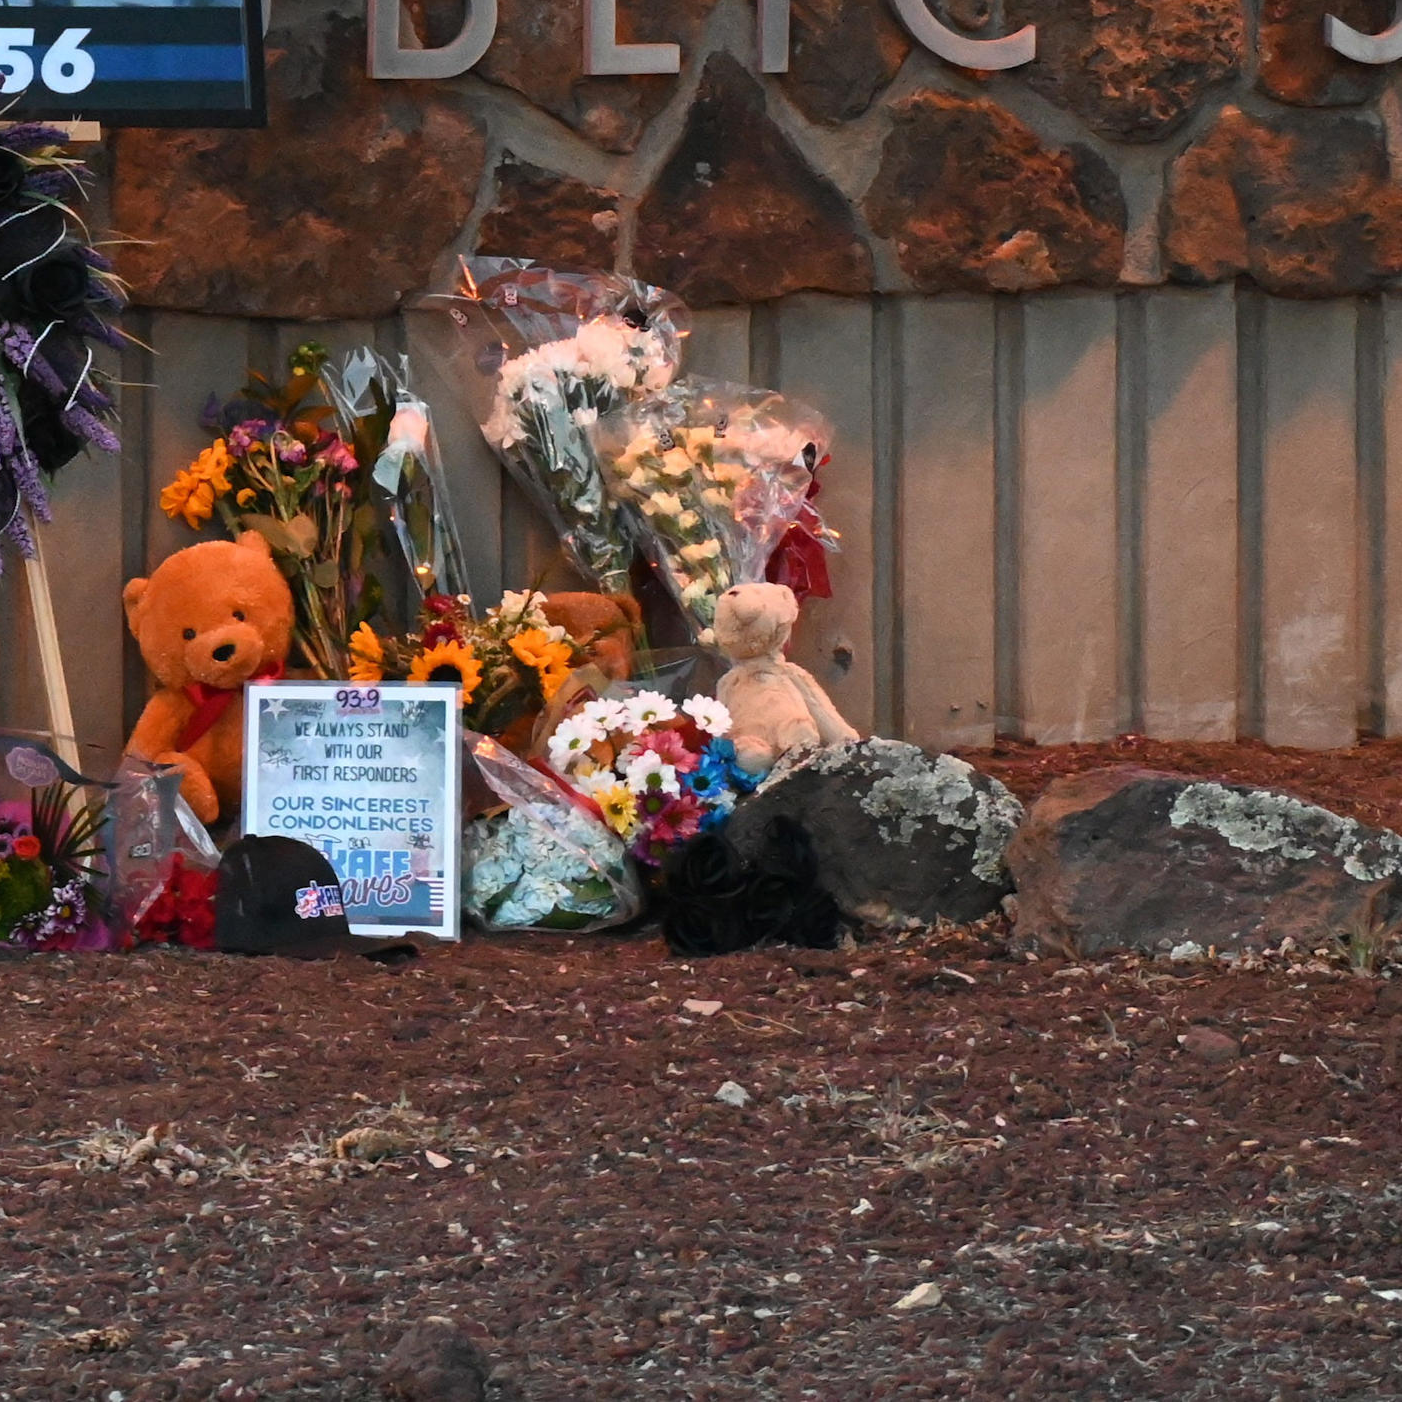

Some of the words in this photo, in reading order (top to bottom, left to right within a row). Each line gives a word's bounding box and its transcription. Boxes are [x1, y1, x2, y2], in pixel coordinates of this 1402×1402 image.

[295, 722, 311, 737] WE
[314, 722, 364, 737] ALWAYS
[367, 722, 409, 738] STAND
[324, 744, 352, 759] WITH
[356, 744, 383, 760] OUR
[292, 765, 330, 782] FIRST
[333, 766, 418, 783] RESPONDERS
[272, 796, 315, 811] OUR
[322, 796, 431, 814] SINCEREST
[268, 814, 434, 833] CONDONLENCES
[323, 840, 410, 878] KAFF
[343, 871, 413, 907] ares
